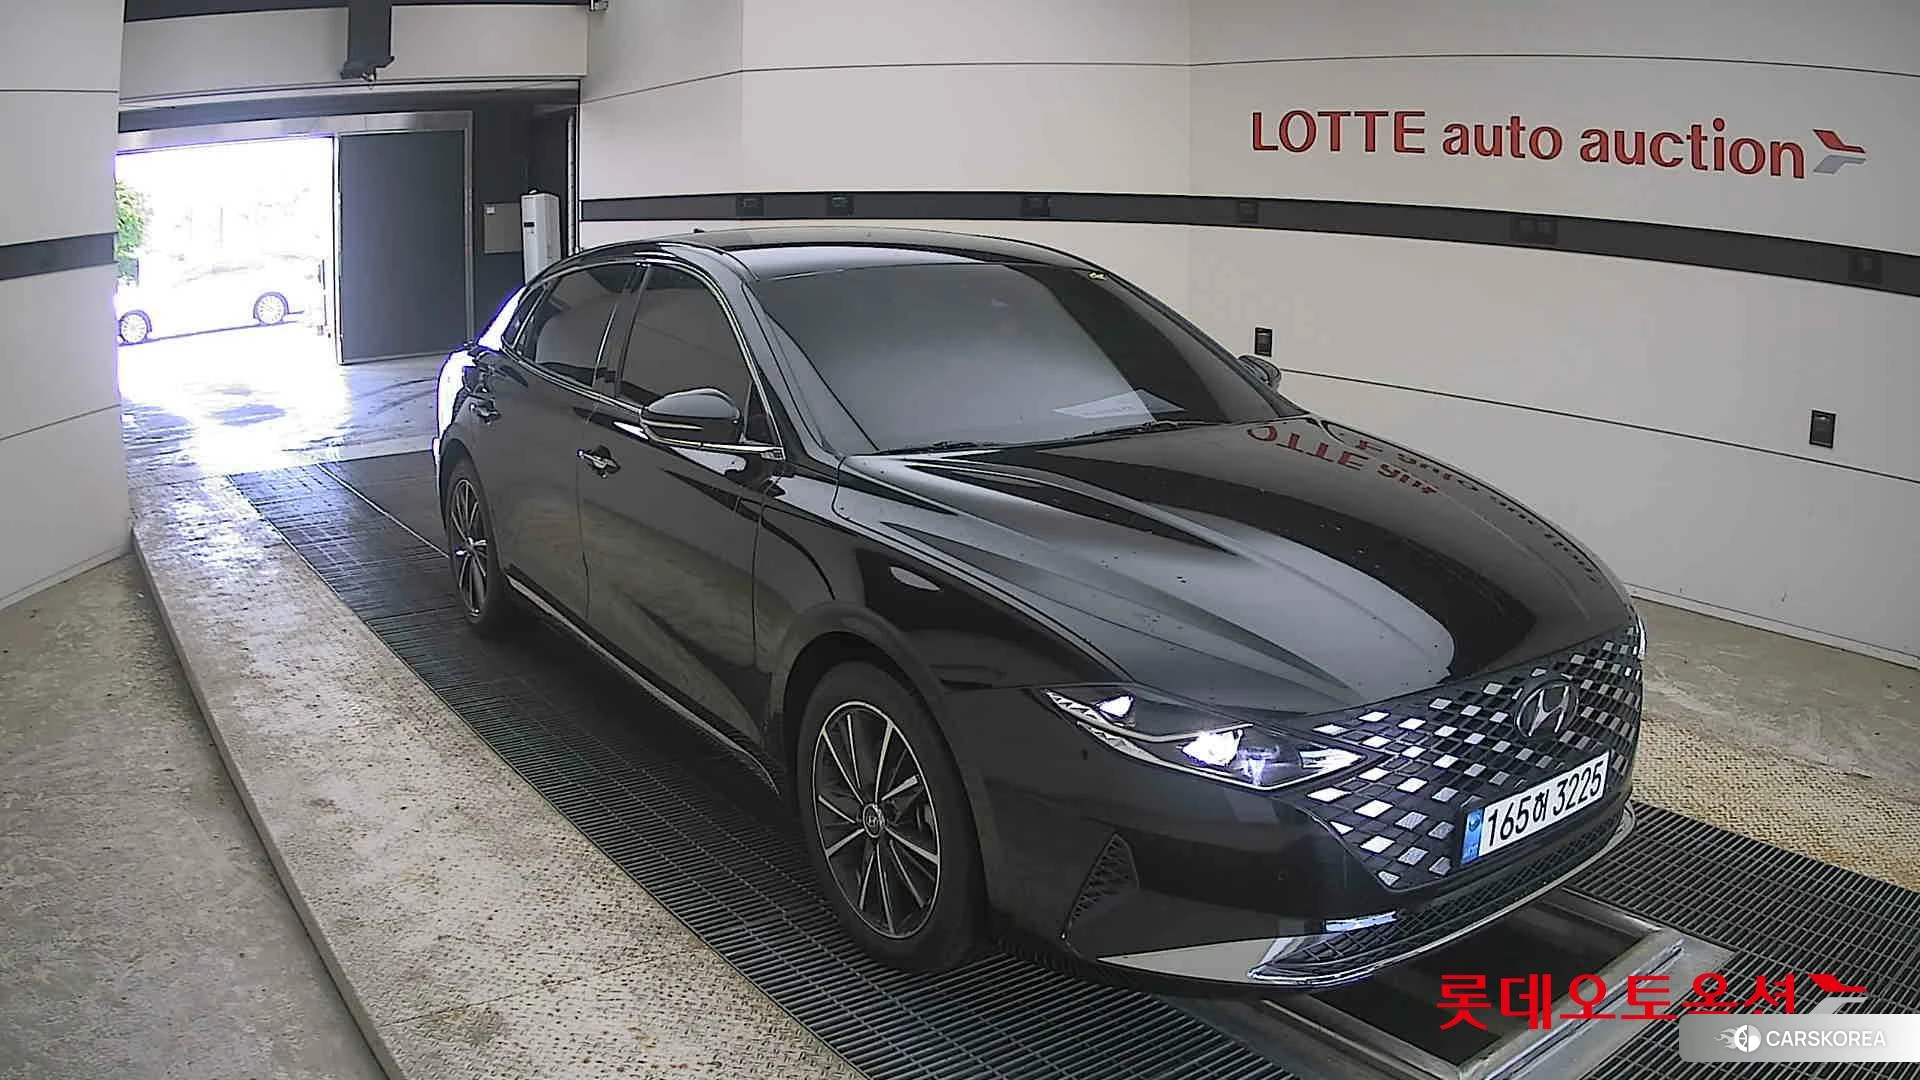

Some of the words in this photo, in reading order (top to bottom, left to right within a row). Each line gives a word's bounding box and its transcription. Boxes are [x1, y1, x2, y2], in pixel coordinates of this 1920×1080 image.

[1251, 110, 1426, 154] LOTTE
[1441, 115, 1563, 160] auto
[1579, 117, 1806, 179] auction
[1487, 789, 1550, 847] 165허
[1552, 761, 1604, 817] 3225
